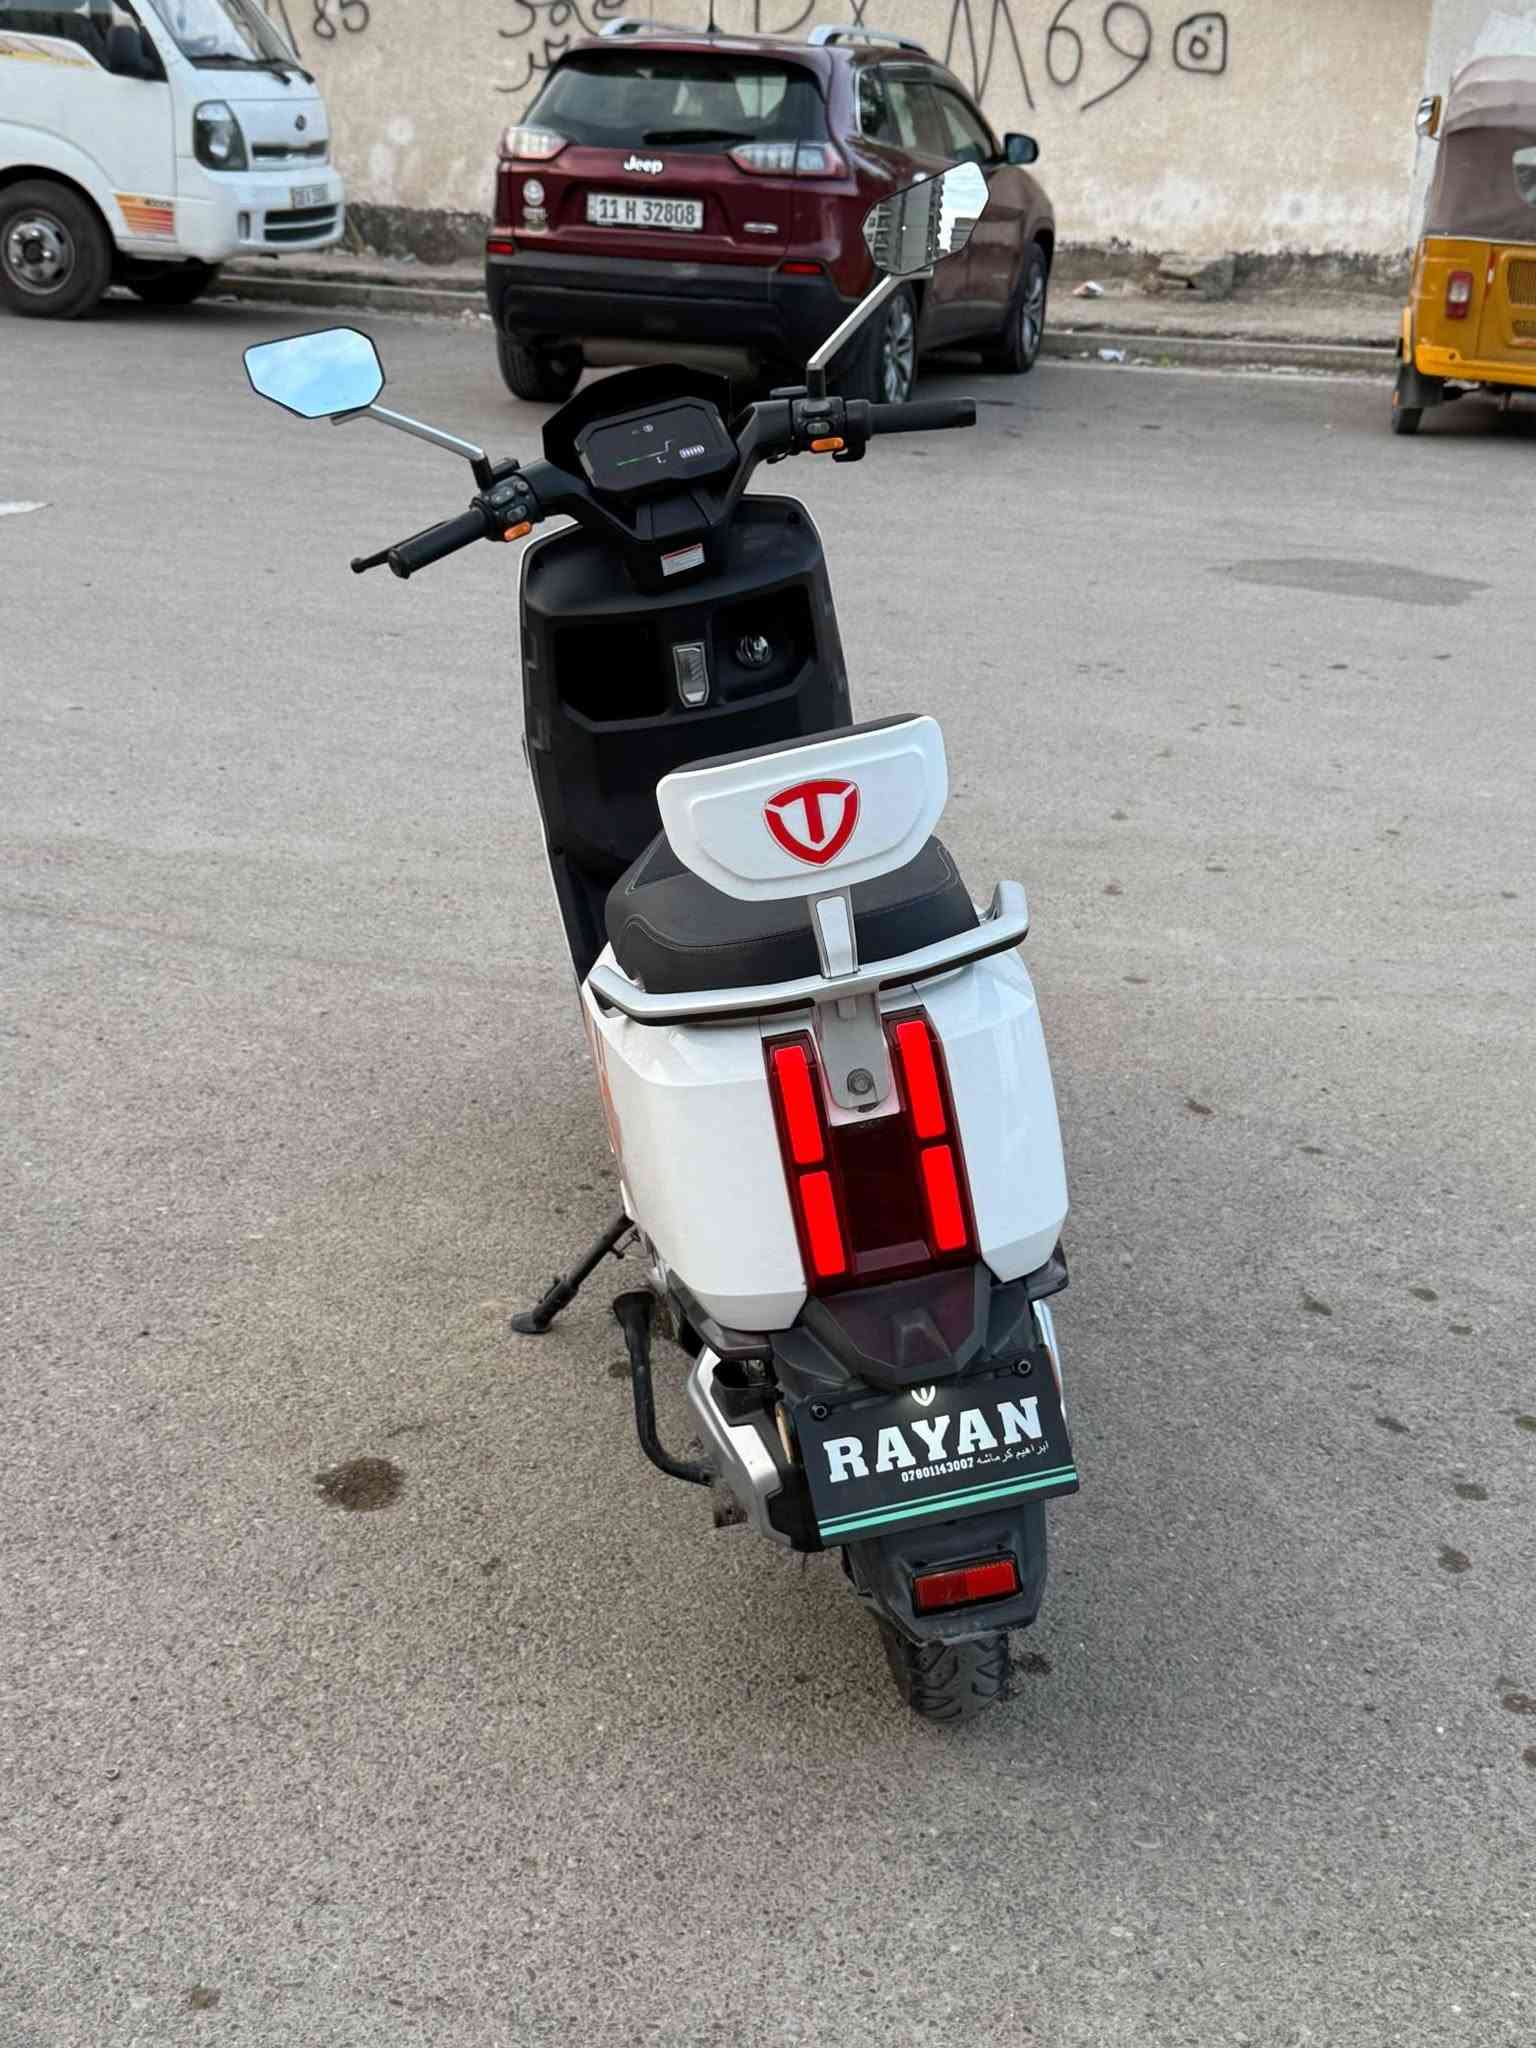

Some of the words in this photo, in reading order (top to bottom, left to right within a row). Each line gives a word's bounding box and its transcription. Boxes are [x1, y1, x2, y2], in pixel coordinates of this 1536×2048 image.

[623, 155, 663, 176] Jeep
[599, 198, 619, 220] 11
[625, 200, 637, 220] H
[642, 201, 696, 226] 32808
[822, 1396, 1043, 1484] RAYAN
